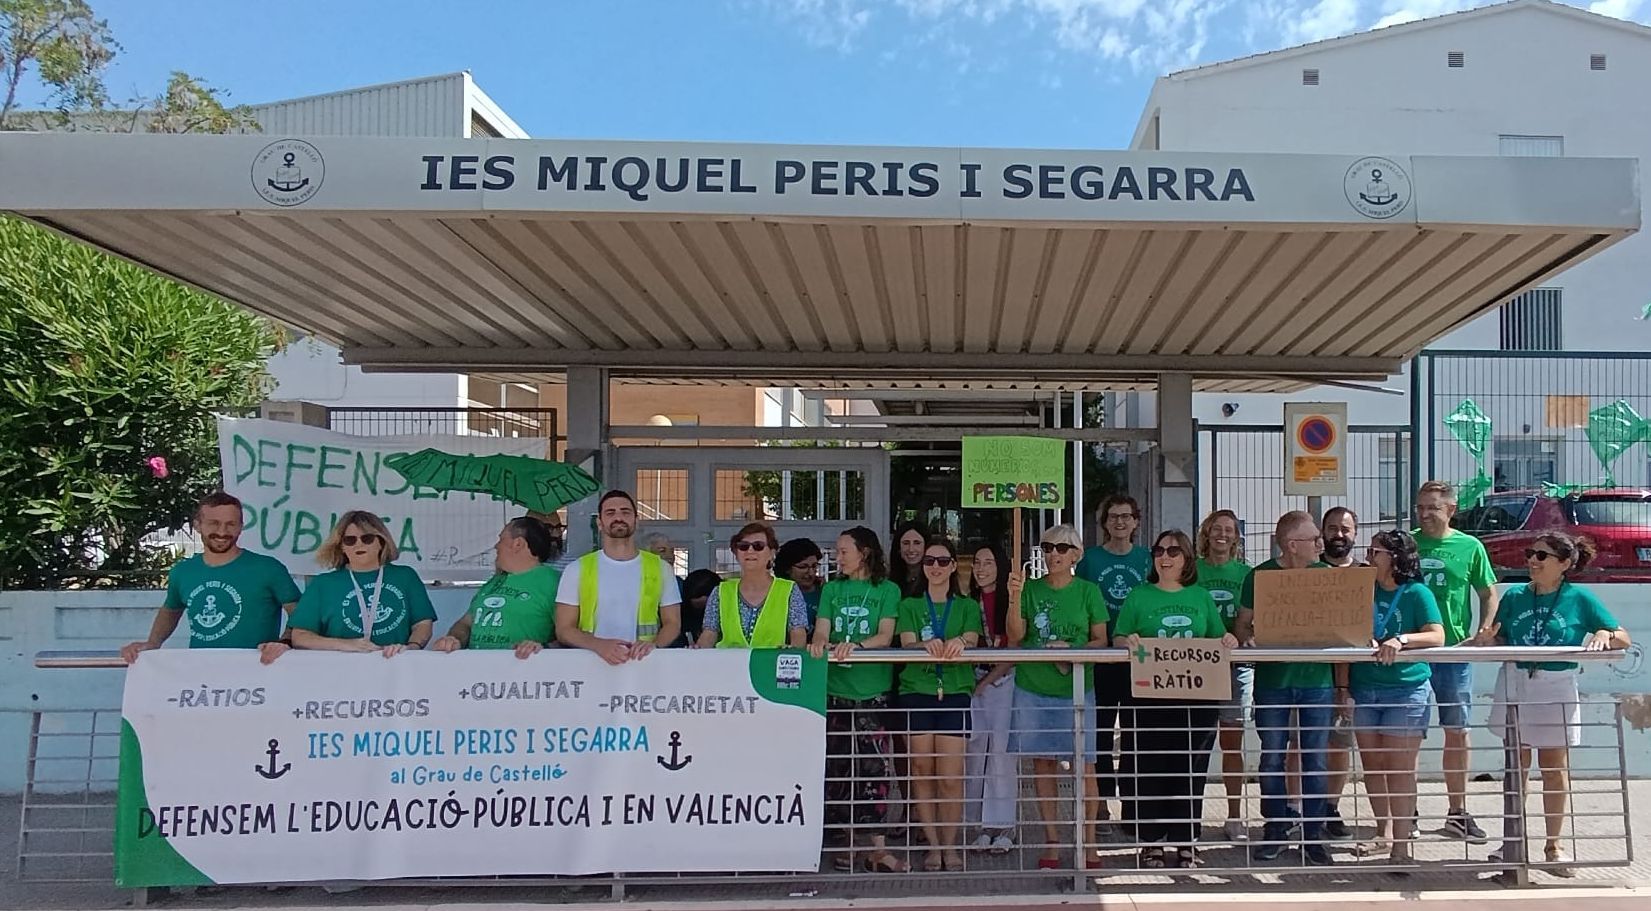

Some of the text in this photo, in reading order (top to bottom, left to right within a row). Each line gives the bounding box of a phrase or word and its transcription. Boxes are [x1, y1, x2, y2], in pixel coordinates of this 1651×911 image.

[420, 155, 1256, 202] IES MIQUEL PERIS I SEGARRA
[984, 440, 1056, 458] NO SOM
[426, 458, 518, 502] MIQUEL
[534, 463, 600, 512] PERIS
[973, 482, 1061, 504] PERSONES
[1154, 648, 1221, 664] RECURSOS
[1153, 669, 1203, 689] RÀTIO
[167, 684, 266, 708] -RÀTIOS
[458, 680, 585, 702] +QUALITAT
[292, 698, 430, 720] +RECURSOS
[599, 694, 760, 715] -PRECARIETAT
[308, 725, 650, 760] IES MIQUEL PERIS I SEGARRA
[391, 763, 568, 785] al Grau de Castelló
[137, 783, 806, 840] DEFENSEM L'EDUCACIÓ PÚBLICA I EN VALENCIÀ
